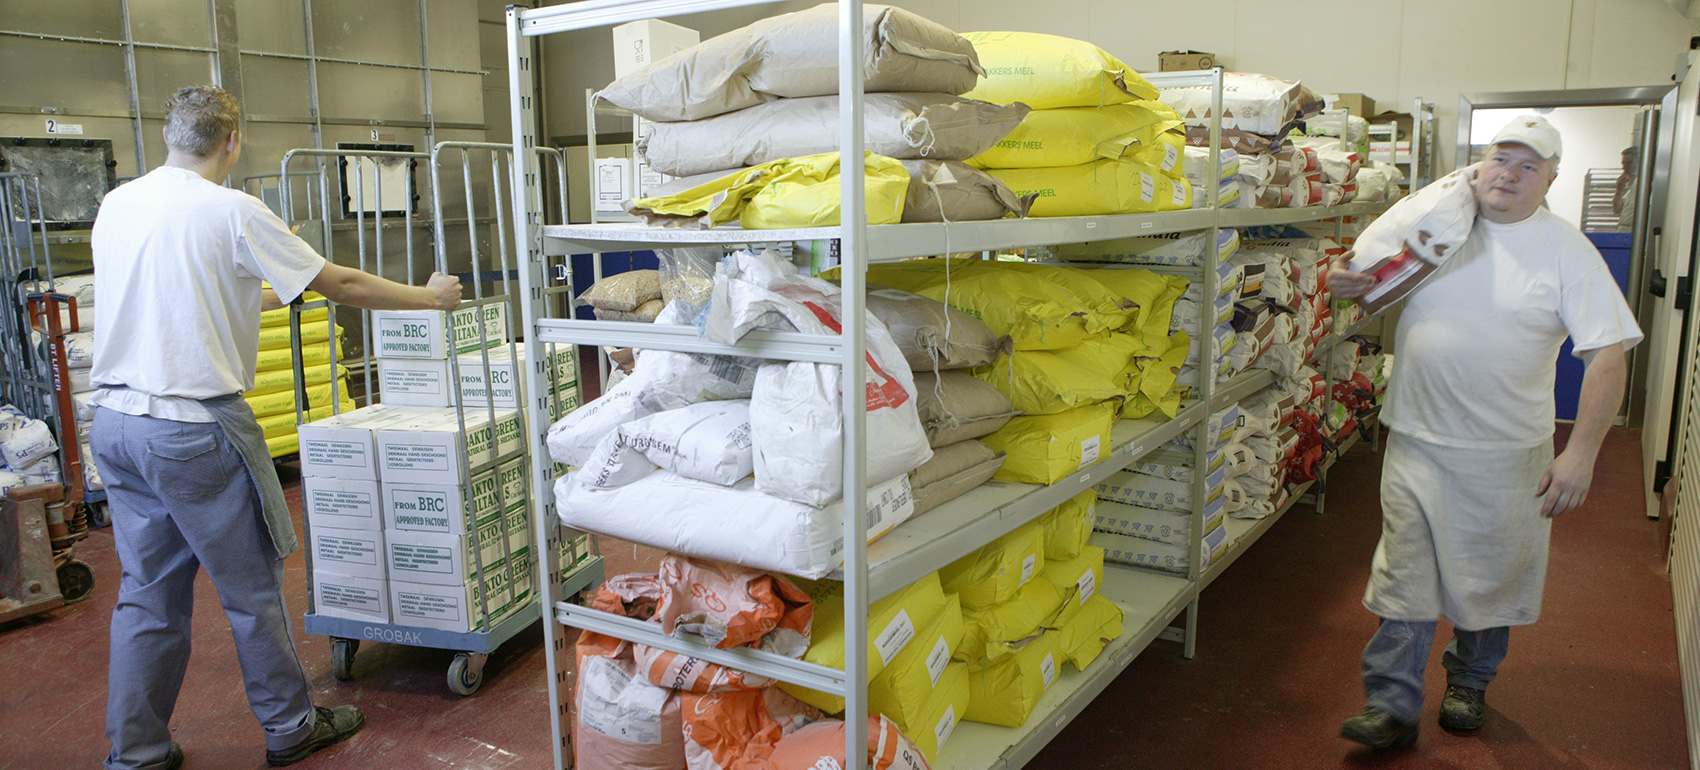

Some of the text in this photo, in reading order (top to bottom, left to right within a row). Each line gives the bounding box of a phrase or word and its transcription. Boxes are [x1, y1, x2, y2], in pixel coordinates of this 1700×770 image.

[47, 119, 55, 133] 2
[372, 129, 378, 140] 3
[382, 324, 428, 338] FROM BRC
[384, 343, 430, 353] APPROVED FACTORY
[461, 370, 509, 384] FROM RC
[490, 388, 513, 398] ACTORY
[394, 496, 445, 512] FROM BRC
[396, 515, 449, 527] APPROVED FACTORY
[363, 626, 423, 644] GROBAK
[672, 656, 700, 691] BOTER
